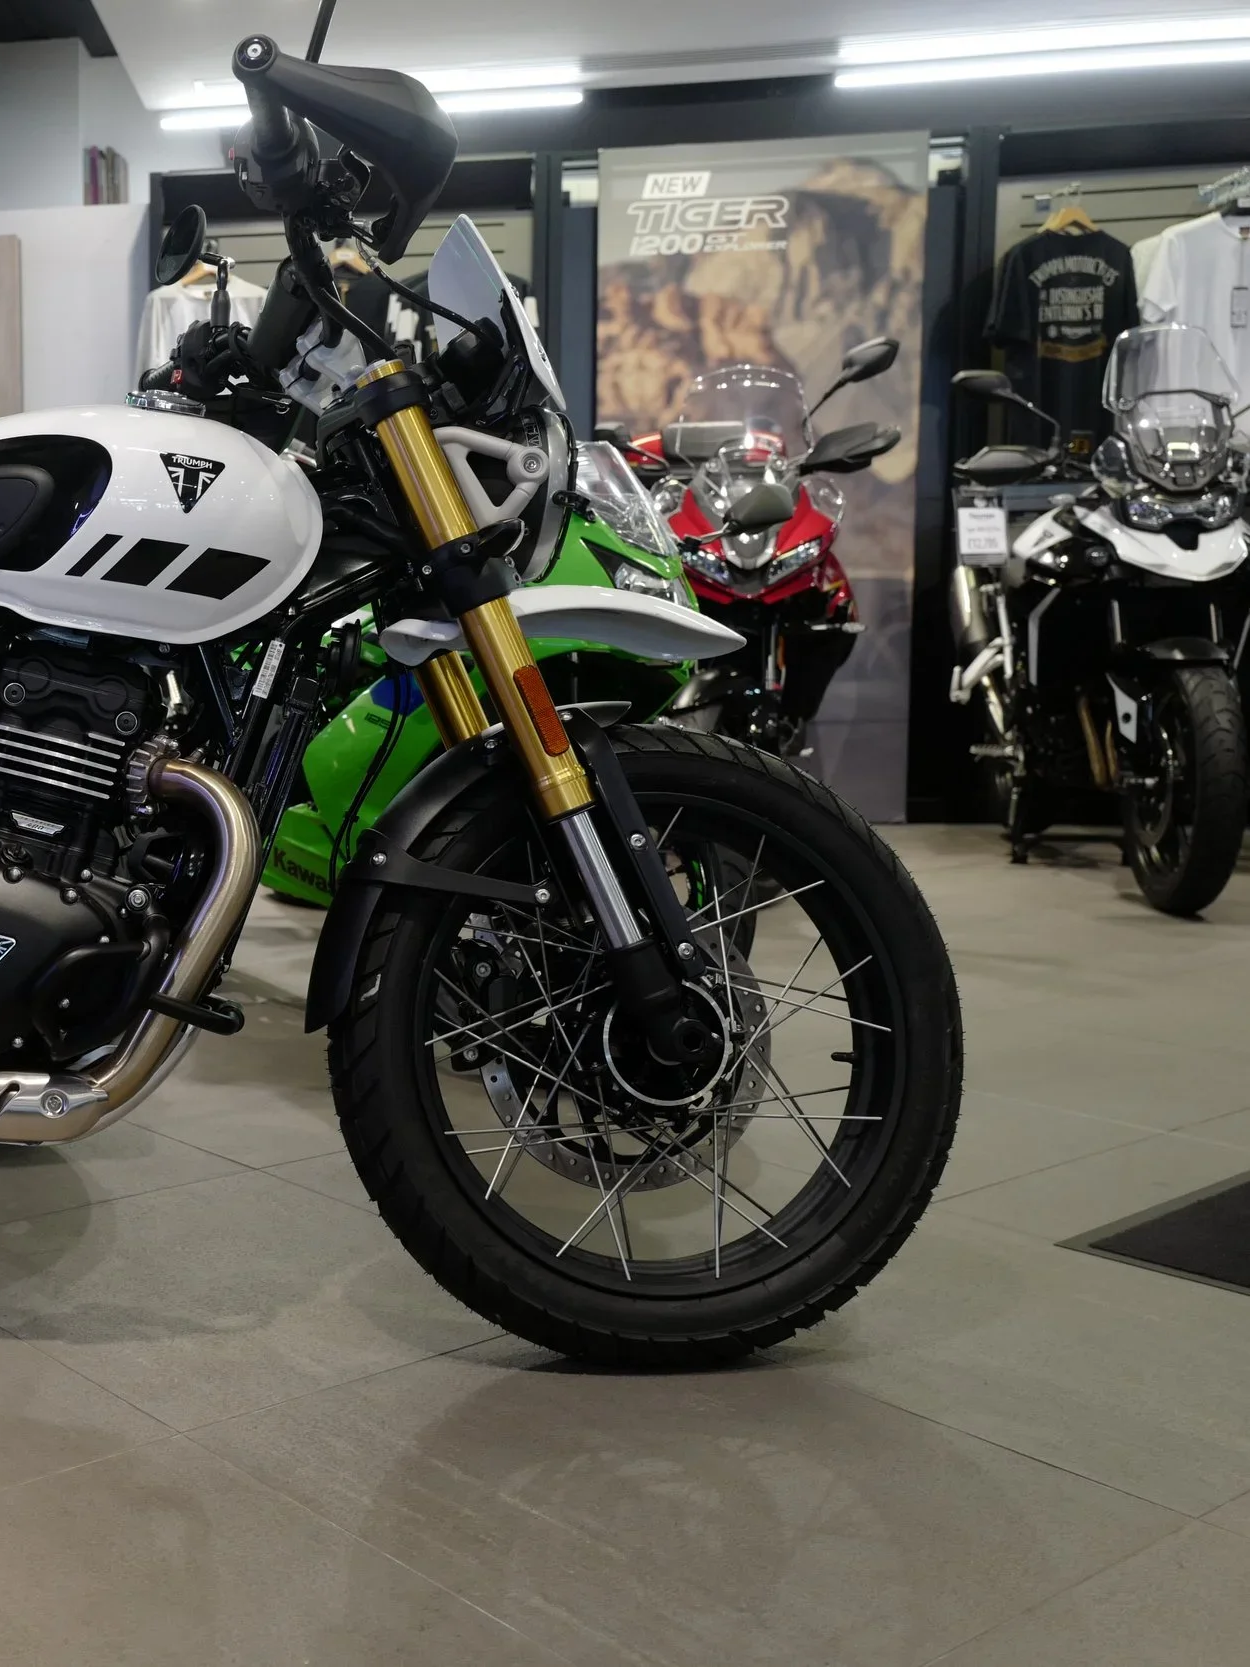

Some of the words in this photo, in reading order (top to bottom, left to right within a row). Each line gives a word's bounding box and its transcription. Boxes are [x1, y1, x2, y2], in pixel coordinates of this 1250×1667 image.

[649, 175, 703, 194] NEW
[626, 195, 789, 234] TIGER
[629, 233, 704, 256] 1200
[171, 455, 213, 469] TRIUMPH
[273, 846, 335, 894] Kawa
